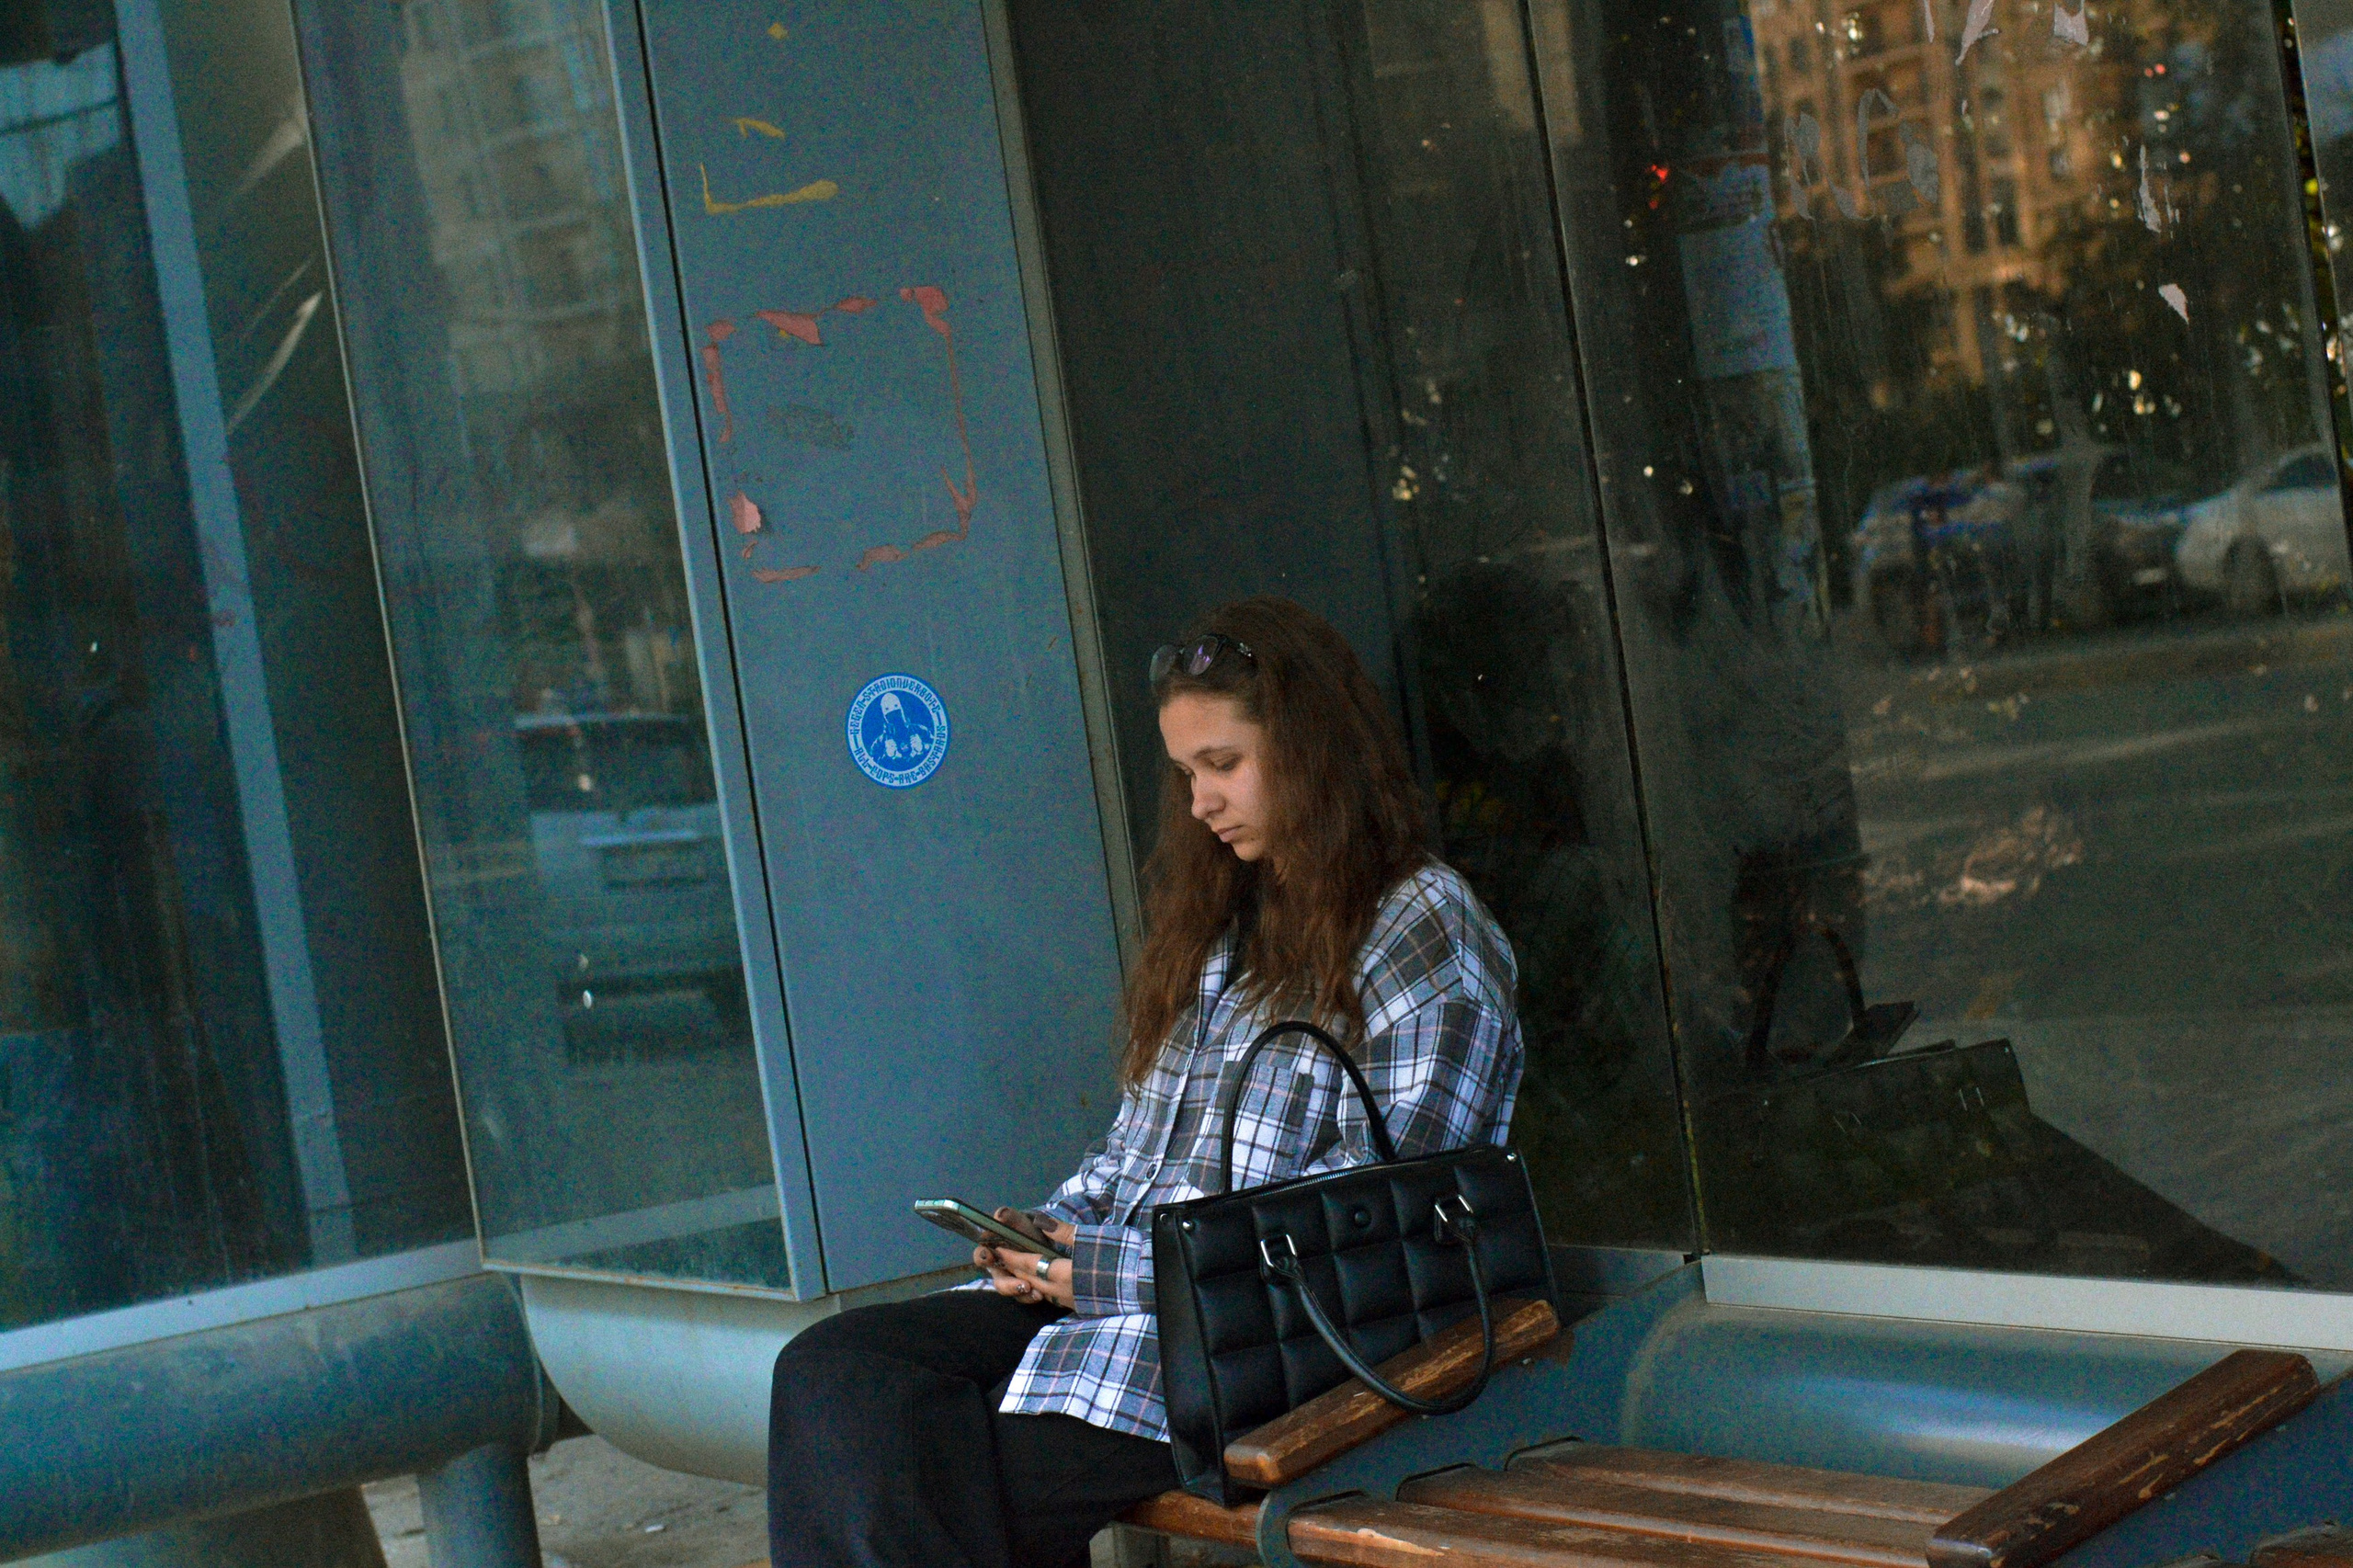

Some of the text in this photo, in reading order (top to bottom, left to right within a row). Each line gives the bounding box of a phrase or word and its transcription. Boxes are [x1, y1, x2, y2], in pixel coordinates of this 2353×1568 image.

[849, 677, 941, 734] GEGEN STADIONVERBOTE
[854, 725, 947, 785] ALL COPS ARE BASTARDS
